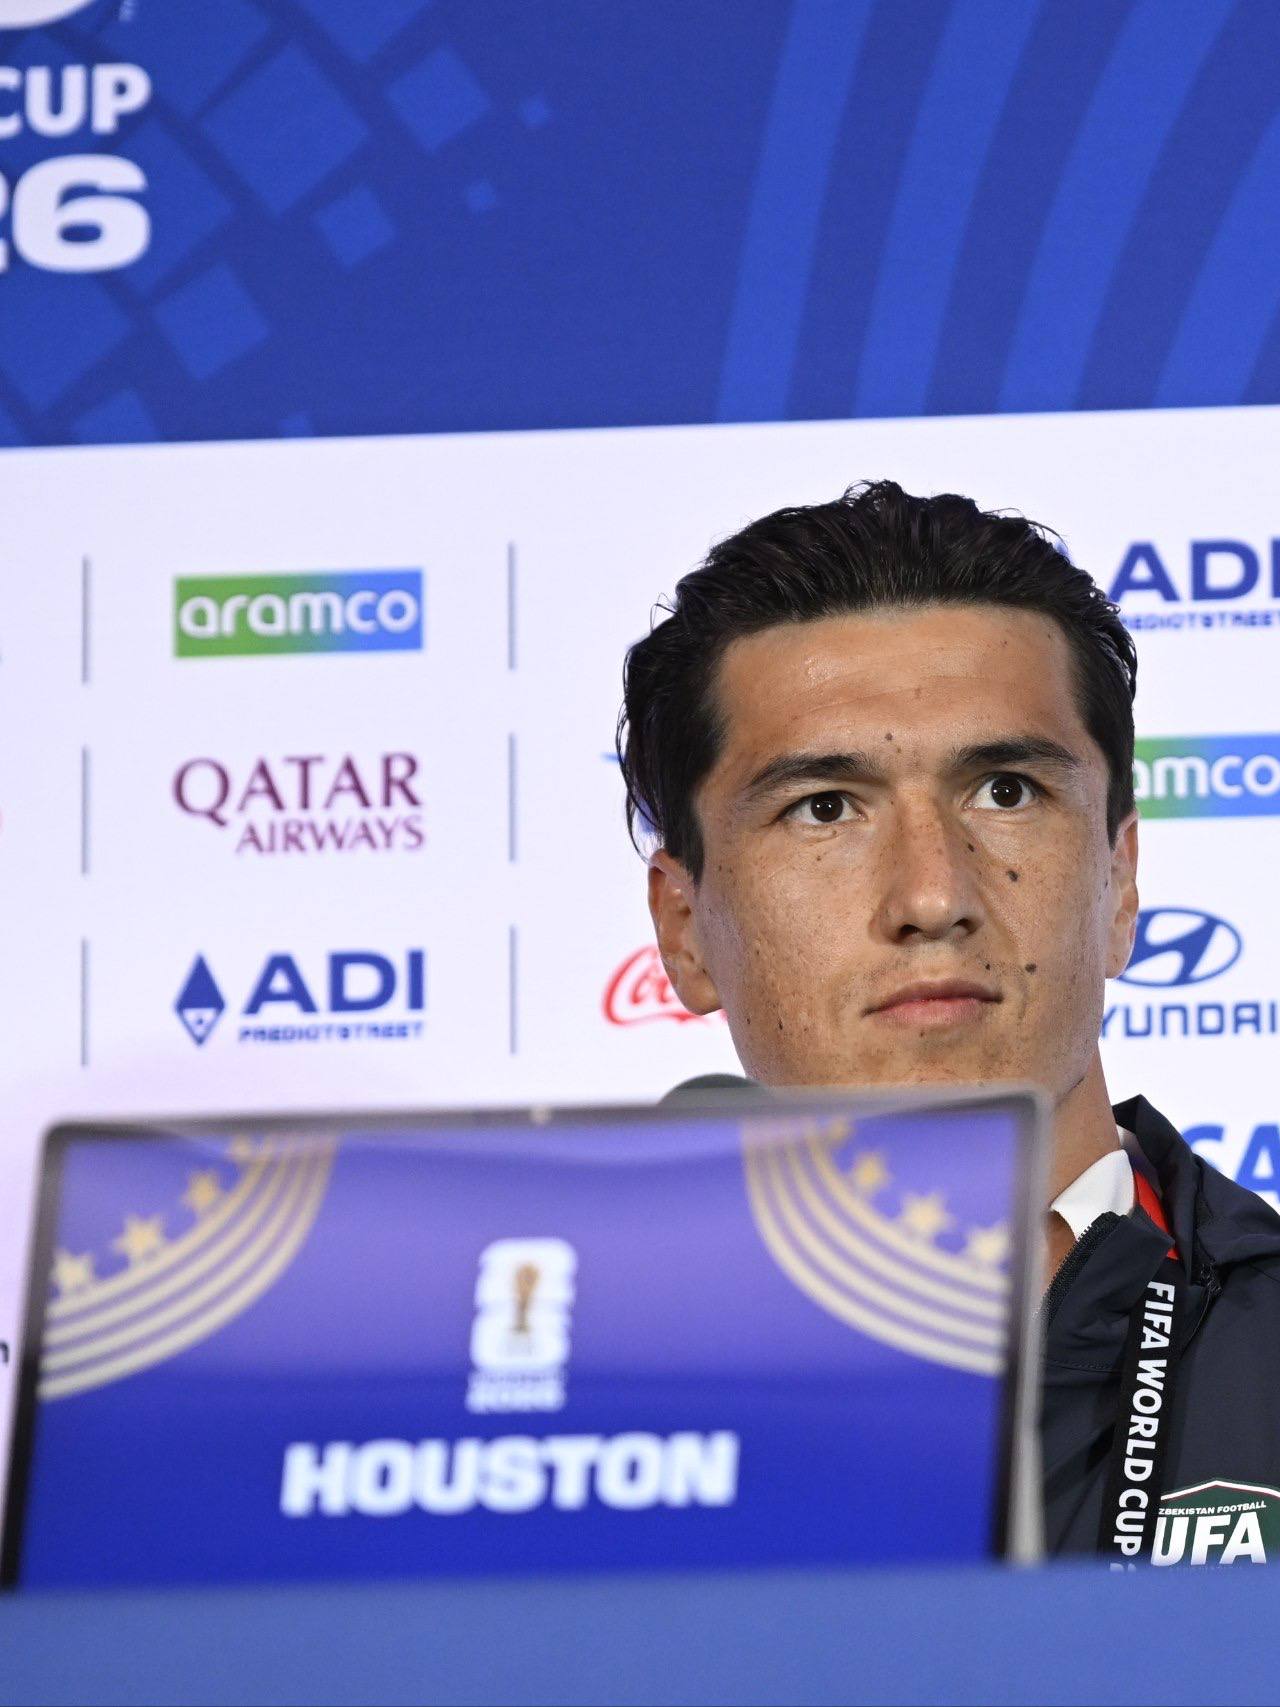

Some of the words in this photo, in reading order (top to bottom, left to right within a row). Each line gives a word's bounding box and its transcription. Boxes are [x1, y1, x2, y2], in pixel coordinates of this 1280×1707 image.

[0, 153, 151, 273] 6
[180, 590, 418, 637] aramco
[173, 751, 421, 827] QATAR
[235, 813, 425, 854] AIRWAYS
[243, 948, 425, 1015] ADI
[1139, 1281, 1176, 1350] FIFA
[1122, 1358, 1168, 1483] WORLD
[281, 1430, 740, 1517] HOUSTON
[1216, 1500, 1267, 1514] FOOTBALL
[1113, 1488, 1149, 1556] CUP
[1150, 1511, 1267, 1567] UFA
